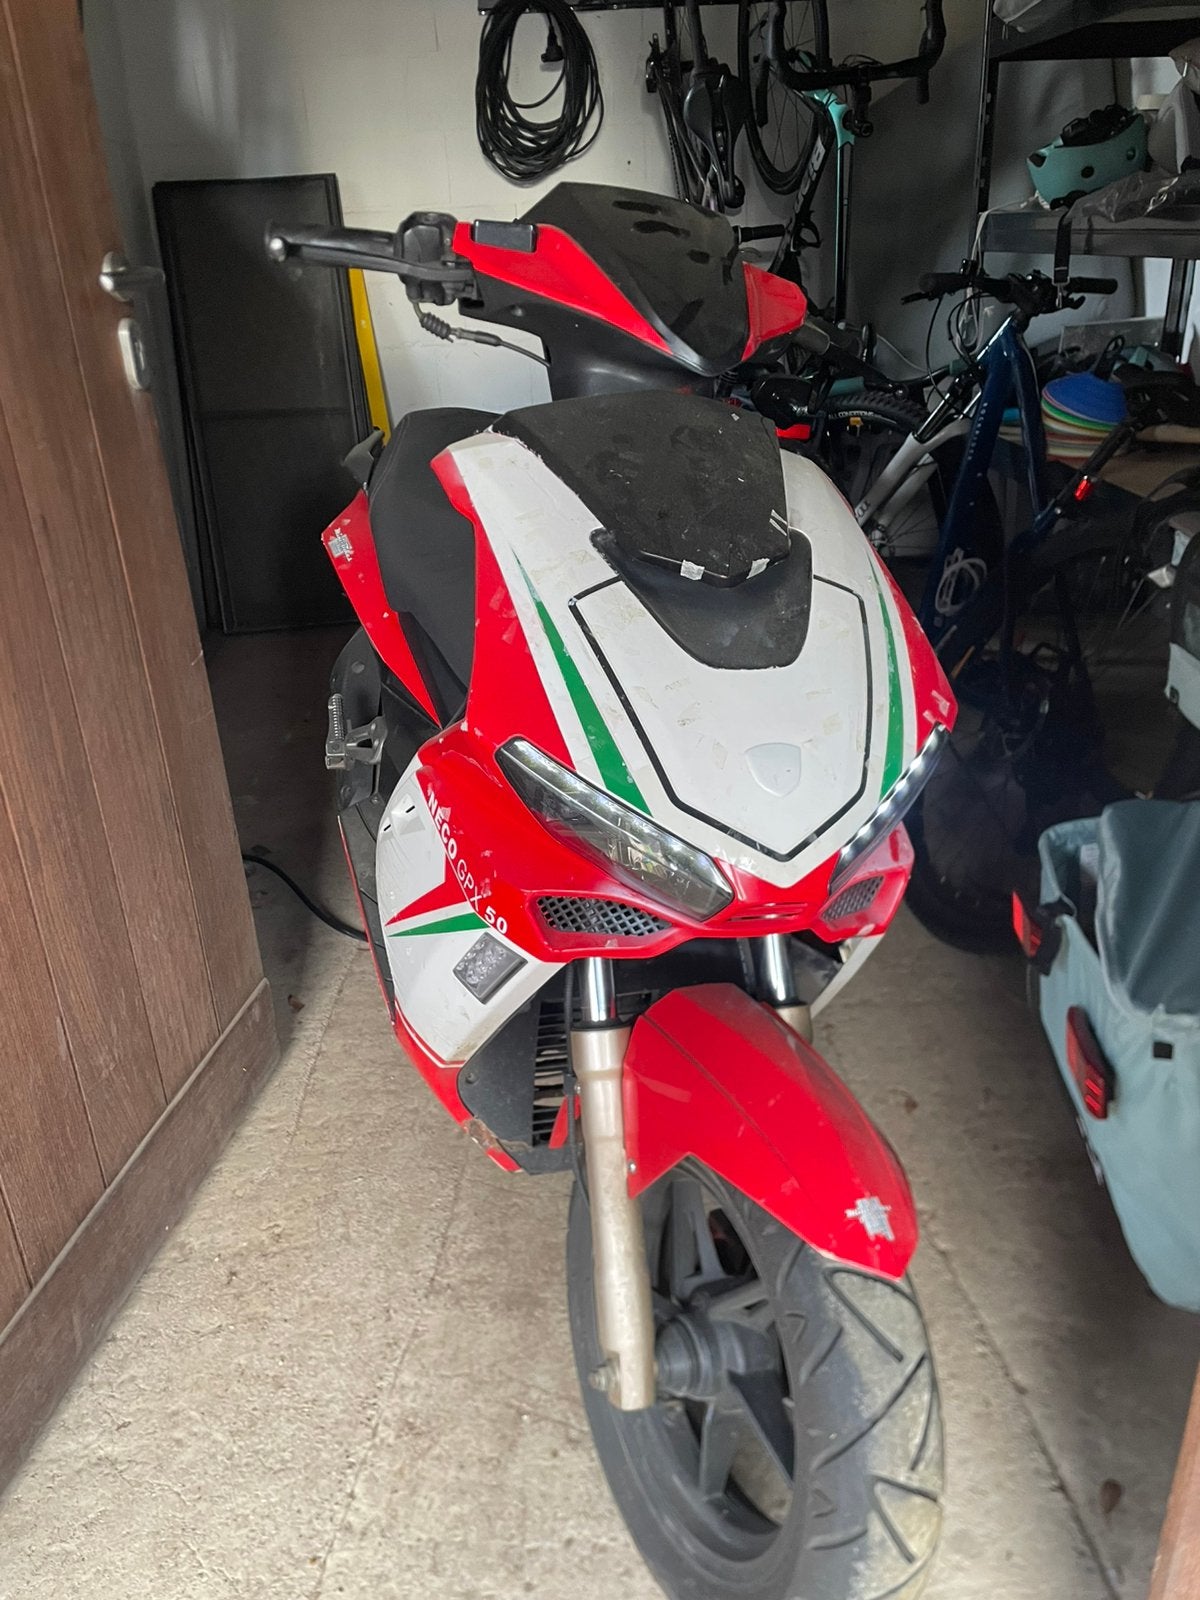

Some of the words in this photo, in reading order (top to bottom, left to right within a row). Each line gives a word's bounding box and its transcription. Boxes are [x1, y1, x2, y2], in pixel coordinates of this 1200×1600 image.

[427, 790, 458, 860] NECO
[456, 859, 482, 912] GPX
[484, 905, 508, 935] 50
